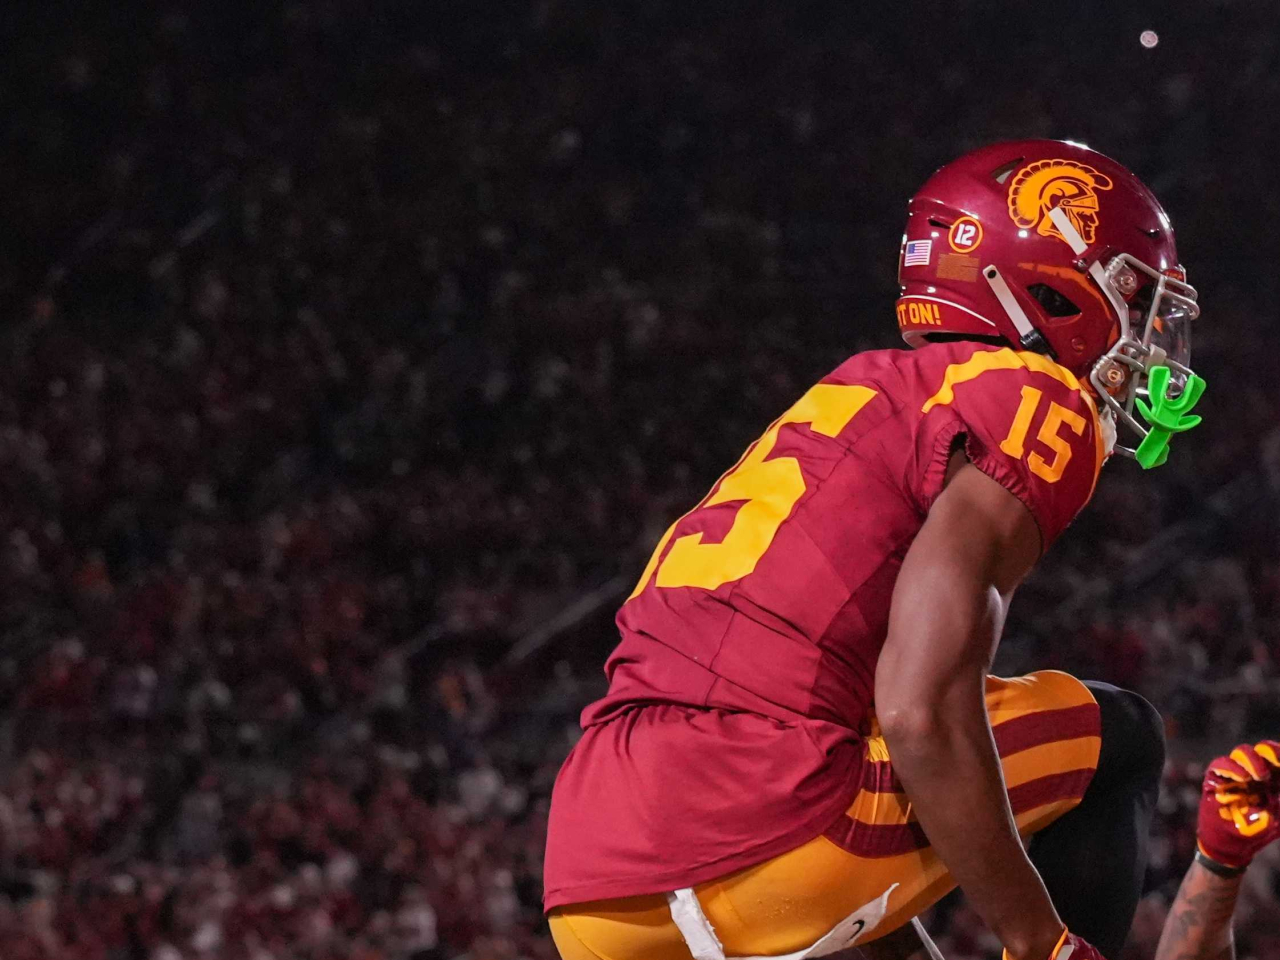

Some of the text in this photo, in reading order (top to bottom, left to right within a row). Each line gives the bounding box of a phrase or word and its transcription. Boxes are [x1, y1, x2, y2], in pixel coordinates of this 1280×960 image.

[954, 223, 976, 246] 12
[908, 302, 942, 326] ON!
[999, 384, 1087, 484] 15
